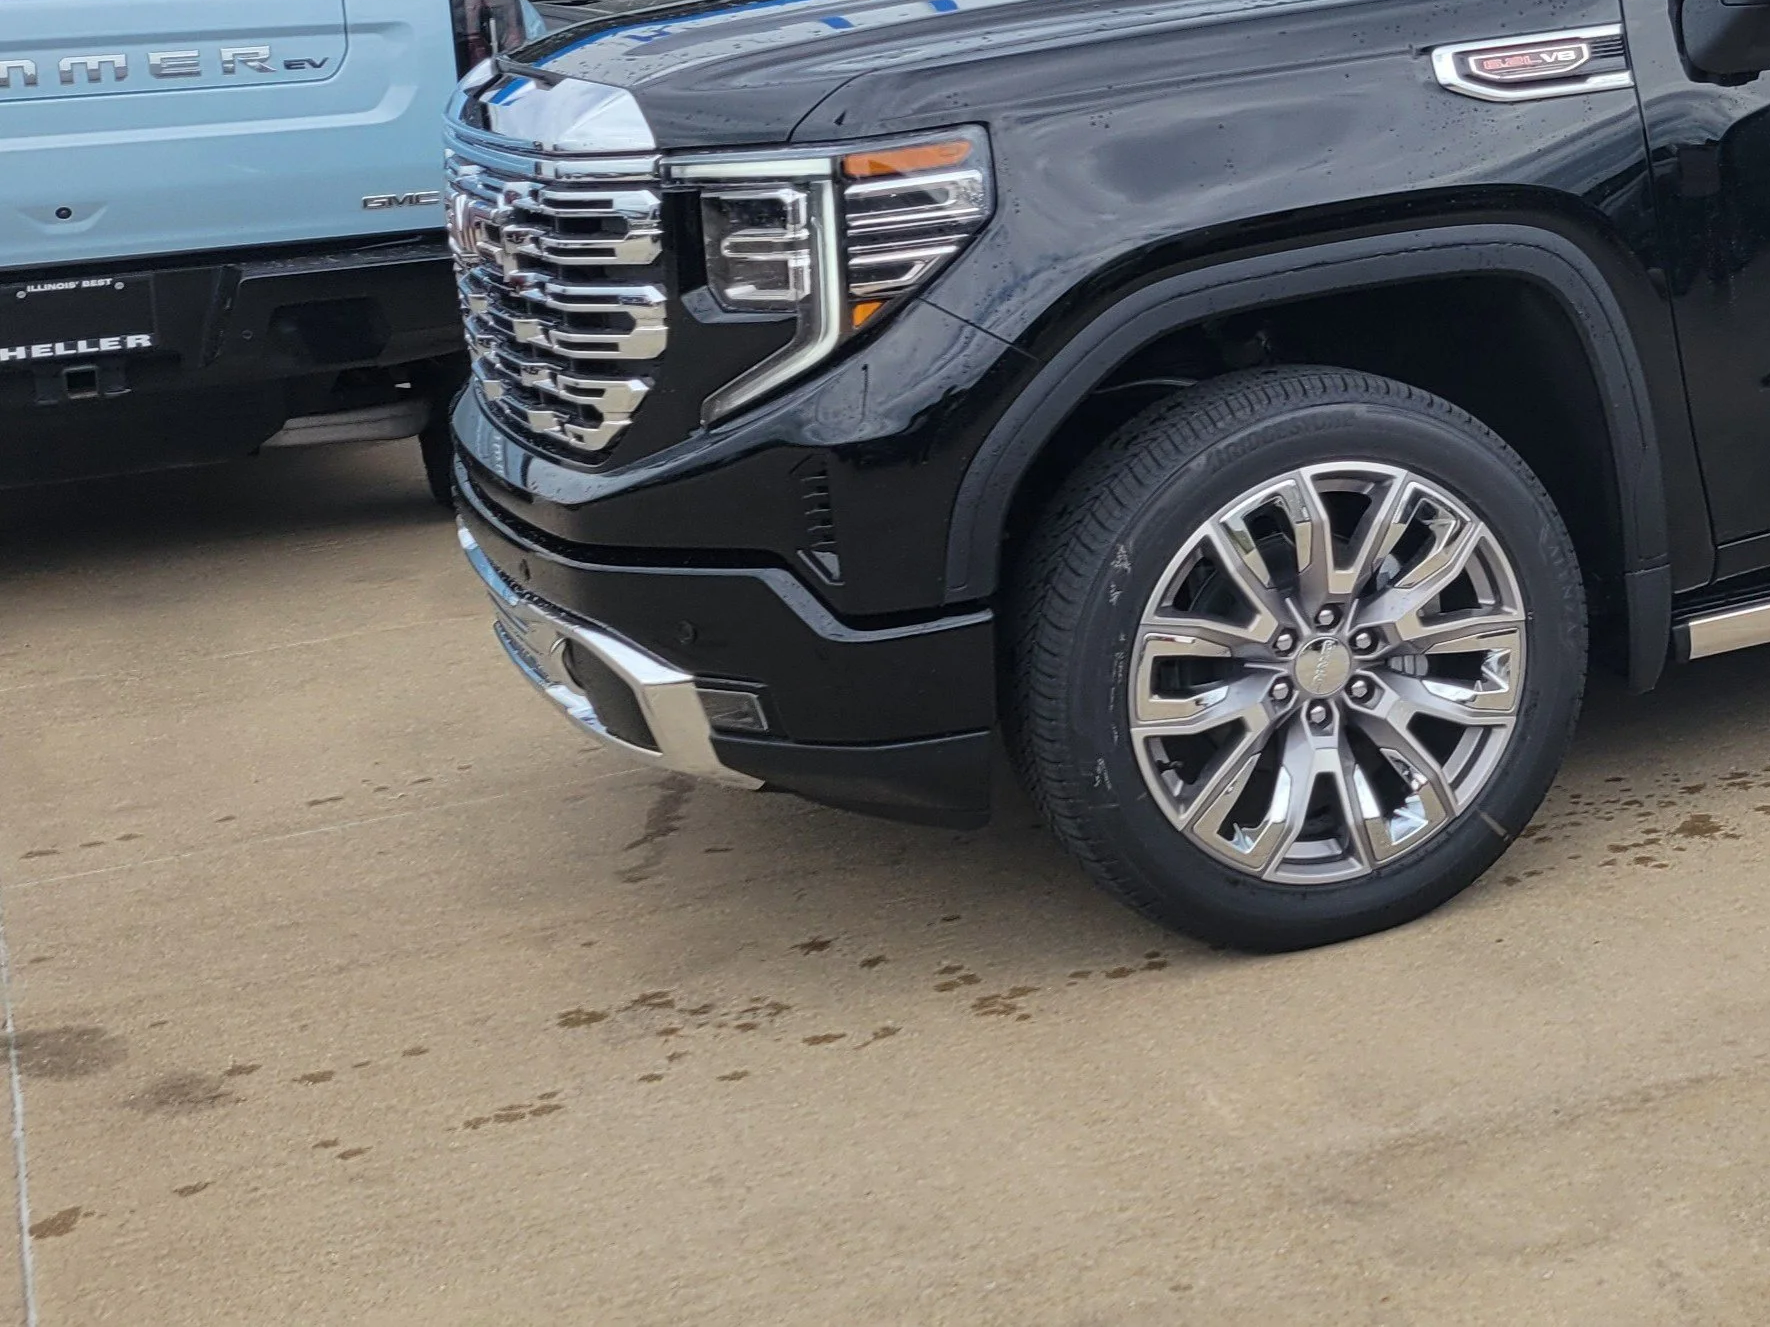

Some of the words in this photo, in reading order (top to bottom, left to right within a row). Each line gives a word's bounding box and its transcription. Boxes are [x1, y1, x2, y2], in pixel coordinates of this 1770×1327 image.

[283, 57, 329, 70] EV
[361, 190, 441, 209] GMC
[81, 278, 113, 288] BEST
[0, 334, 152, 362] HELLER
